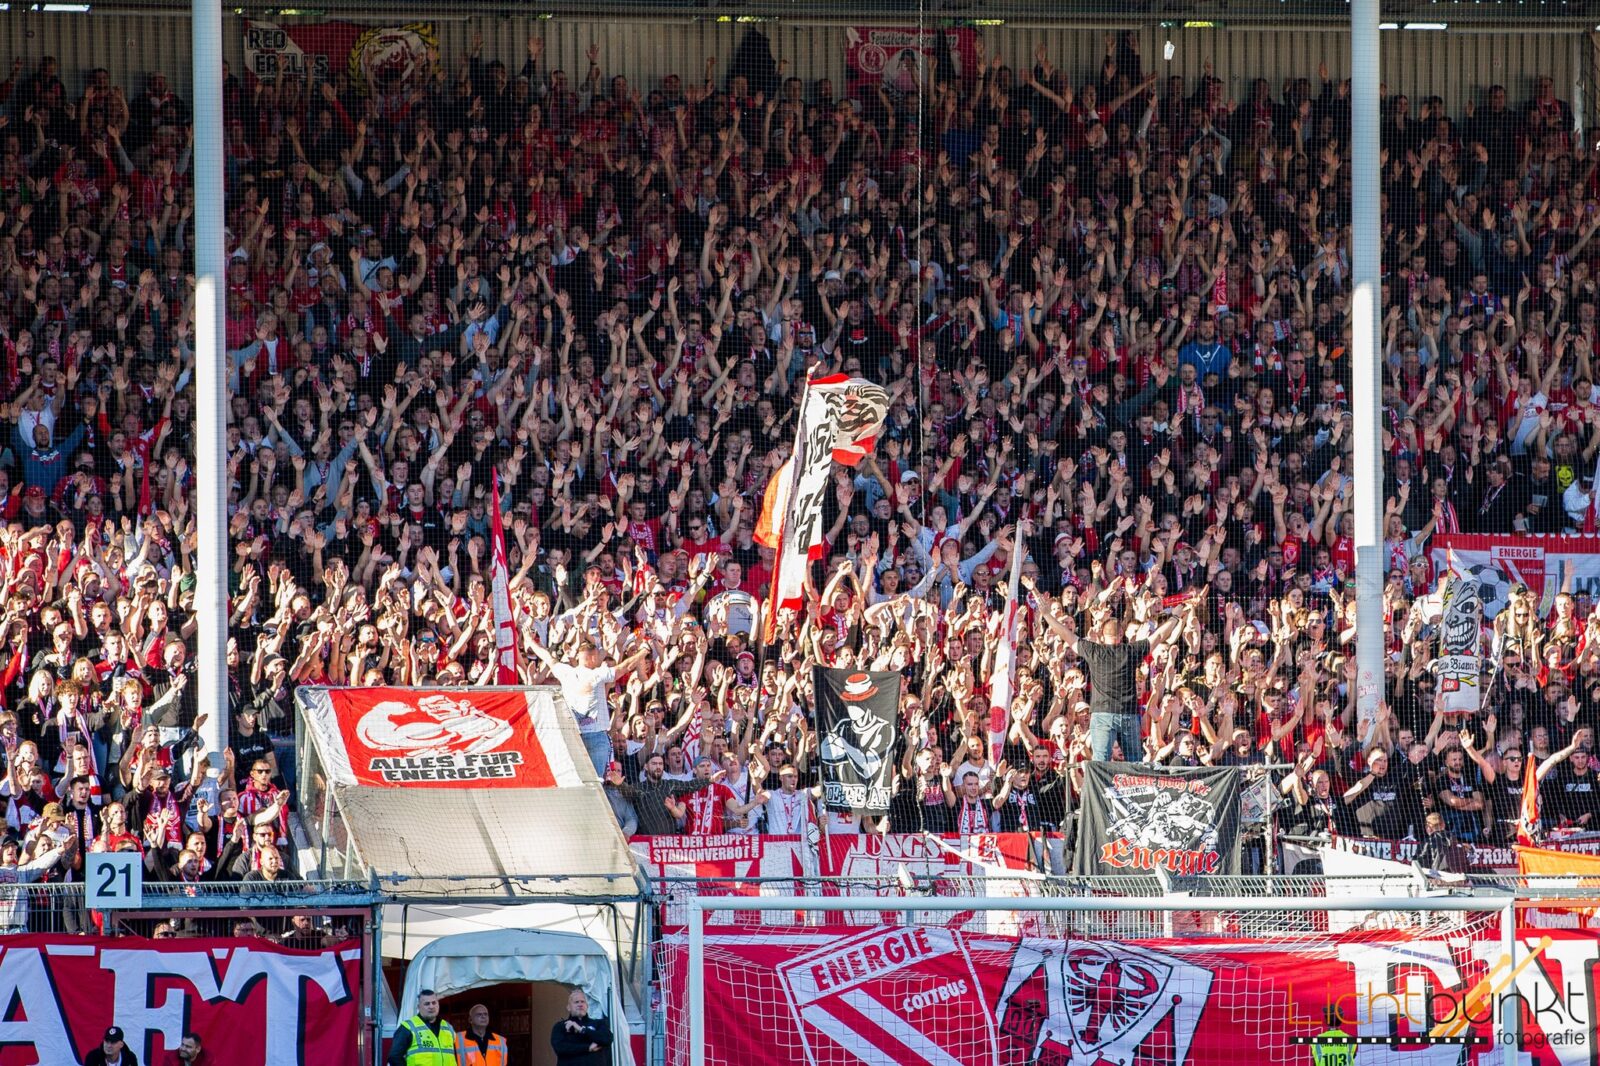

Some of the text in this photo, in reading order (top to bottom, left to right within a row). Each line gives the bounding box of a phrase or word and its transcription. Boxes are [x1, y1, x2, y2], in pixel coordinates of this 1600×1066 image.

[247, 28, 287, 50] RED
[1499, 548, 1537, 559] ENERGIE
[371, 752, 523, 770] ALLES FÜR
[384, 765, 514, 780] ENERGIE!
[652, 836, 680, 848] EHRE
[682, 835, 703, 848] DER
[706, 834, 749, 847] GRUPPE
[653, 845, 750, 862] STADIONVERBOT
[1099, 838, 1220, 877] Energie
[96, 862, 132, 897] 21
[811, 927, 933, 992] ENERGIE
[902, 979, 968, 1013] COTTBUS
